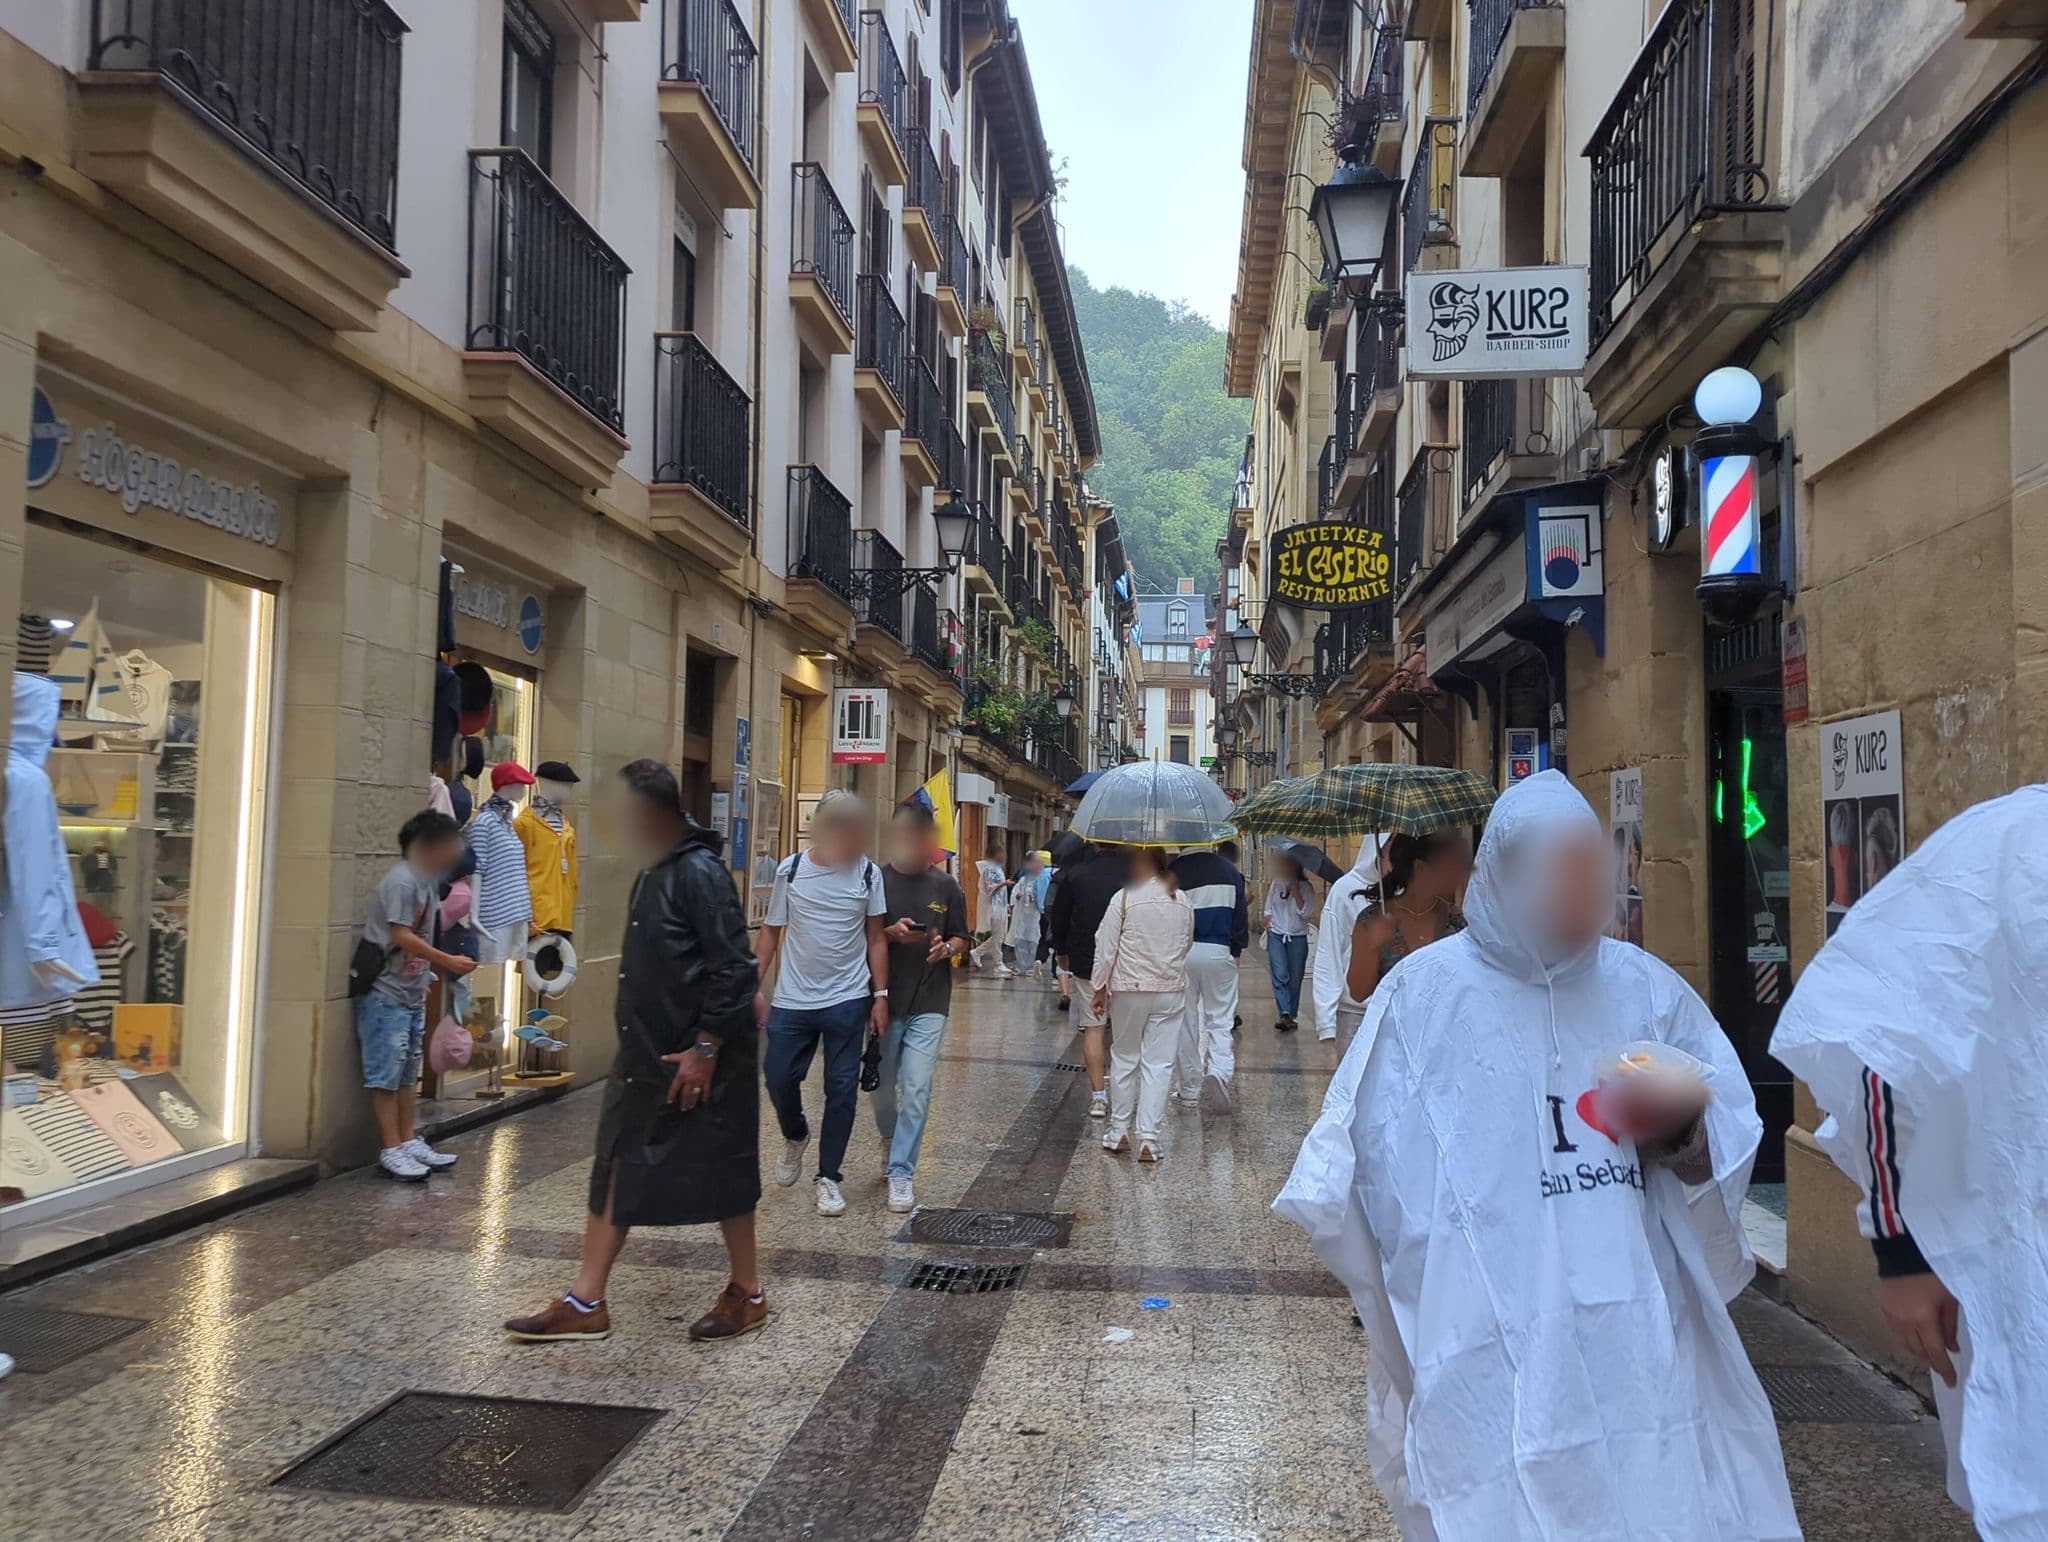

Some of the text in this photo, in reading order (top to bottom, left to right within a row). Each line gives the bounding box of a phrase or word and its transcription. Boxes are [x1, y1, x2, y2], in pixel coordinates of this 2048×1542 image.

[1283, 526, 1383, 548] JATETXEA
[1278, 548, 1303, 577] EL
[1277, 578, 1390, 603] RESTAURANTE
[1546, 1094, 1579, 1153] I
